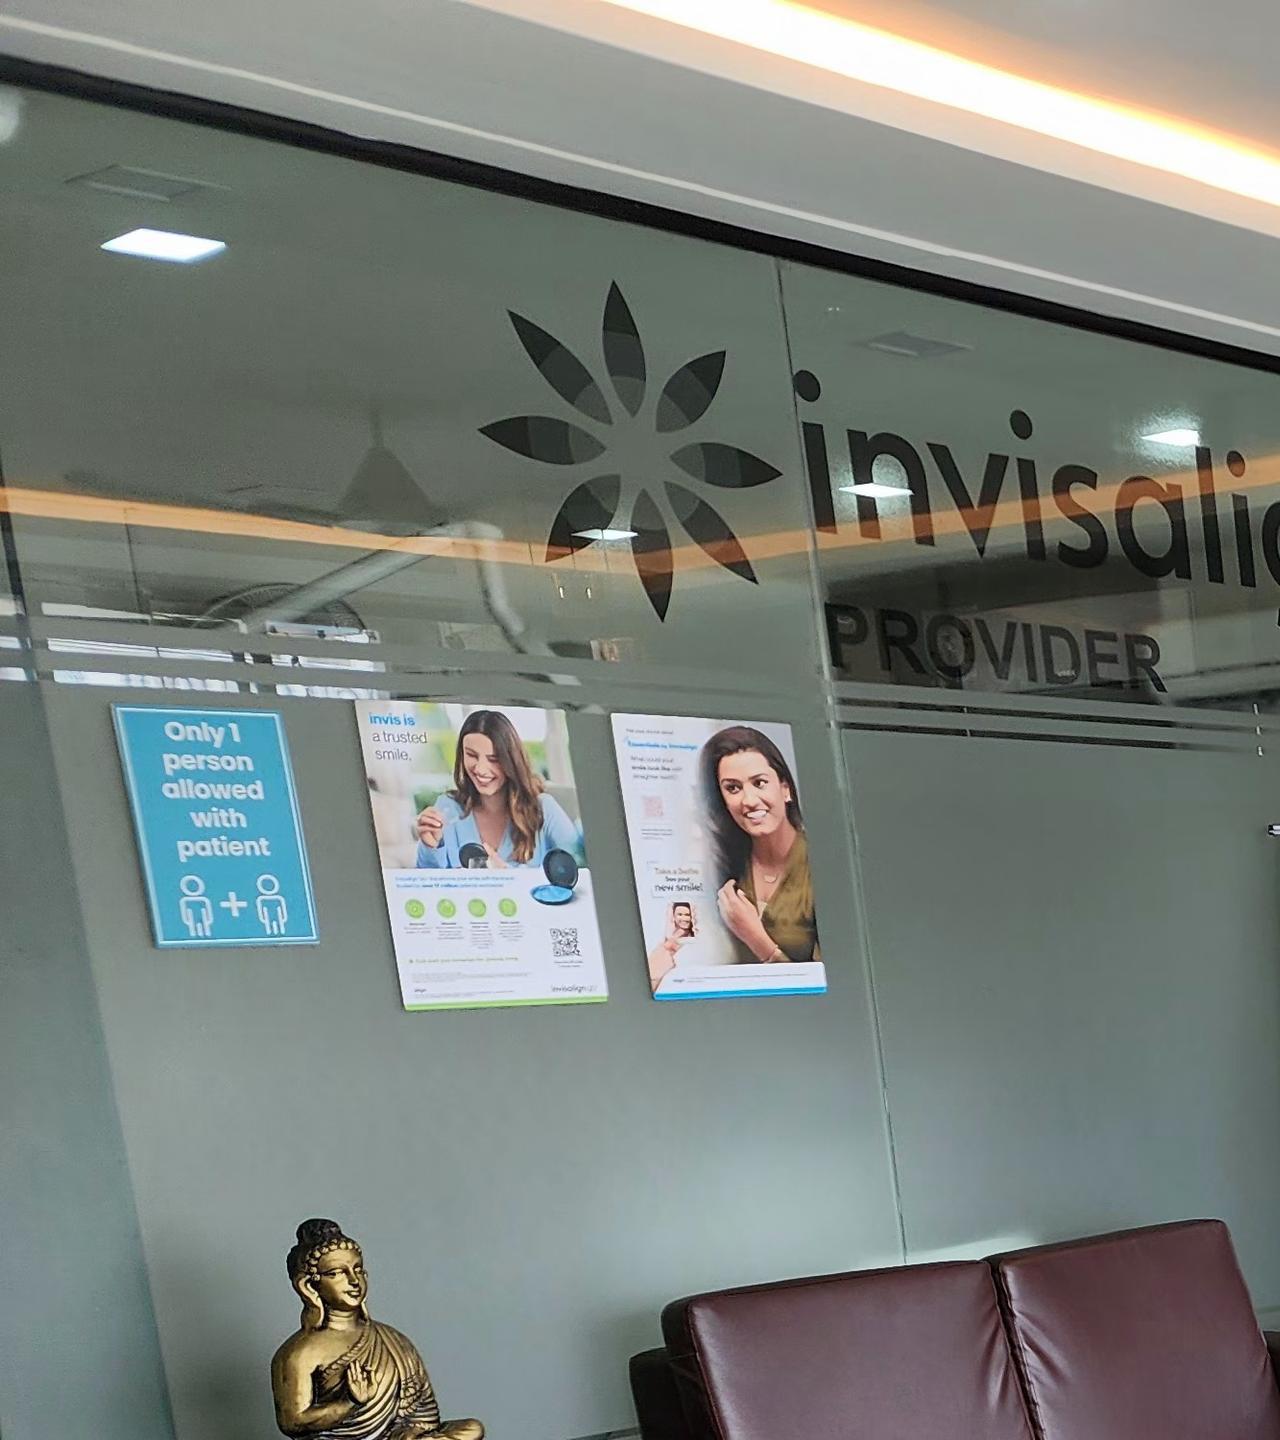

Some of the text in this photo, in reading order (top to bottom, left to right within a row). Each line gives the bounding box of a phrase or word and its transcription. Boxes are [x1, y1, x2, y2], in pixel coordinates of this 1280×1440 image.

[825, 602, 1167, 693] PROVIDER
[369, 712, 415, 726] invis is
[164, 721, 240, 748] Only 1
[372, 731, 427, 744] a trusted
[163, 753, 254, 775] person
[375, 749, 412, 761] smile.
[162, 778, 264, 800] allowed
[189, 807, 247, 828] with
[176, 835, 271, 862] patient
